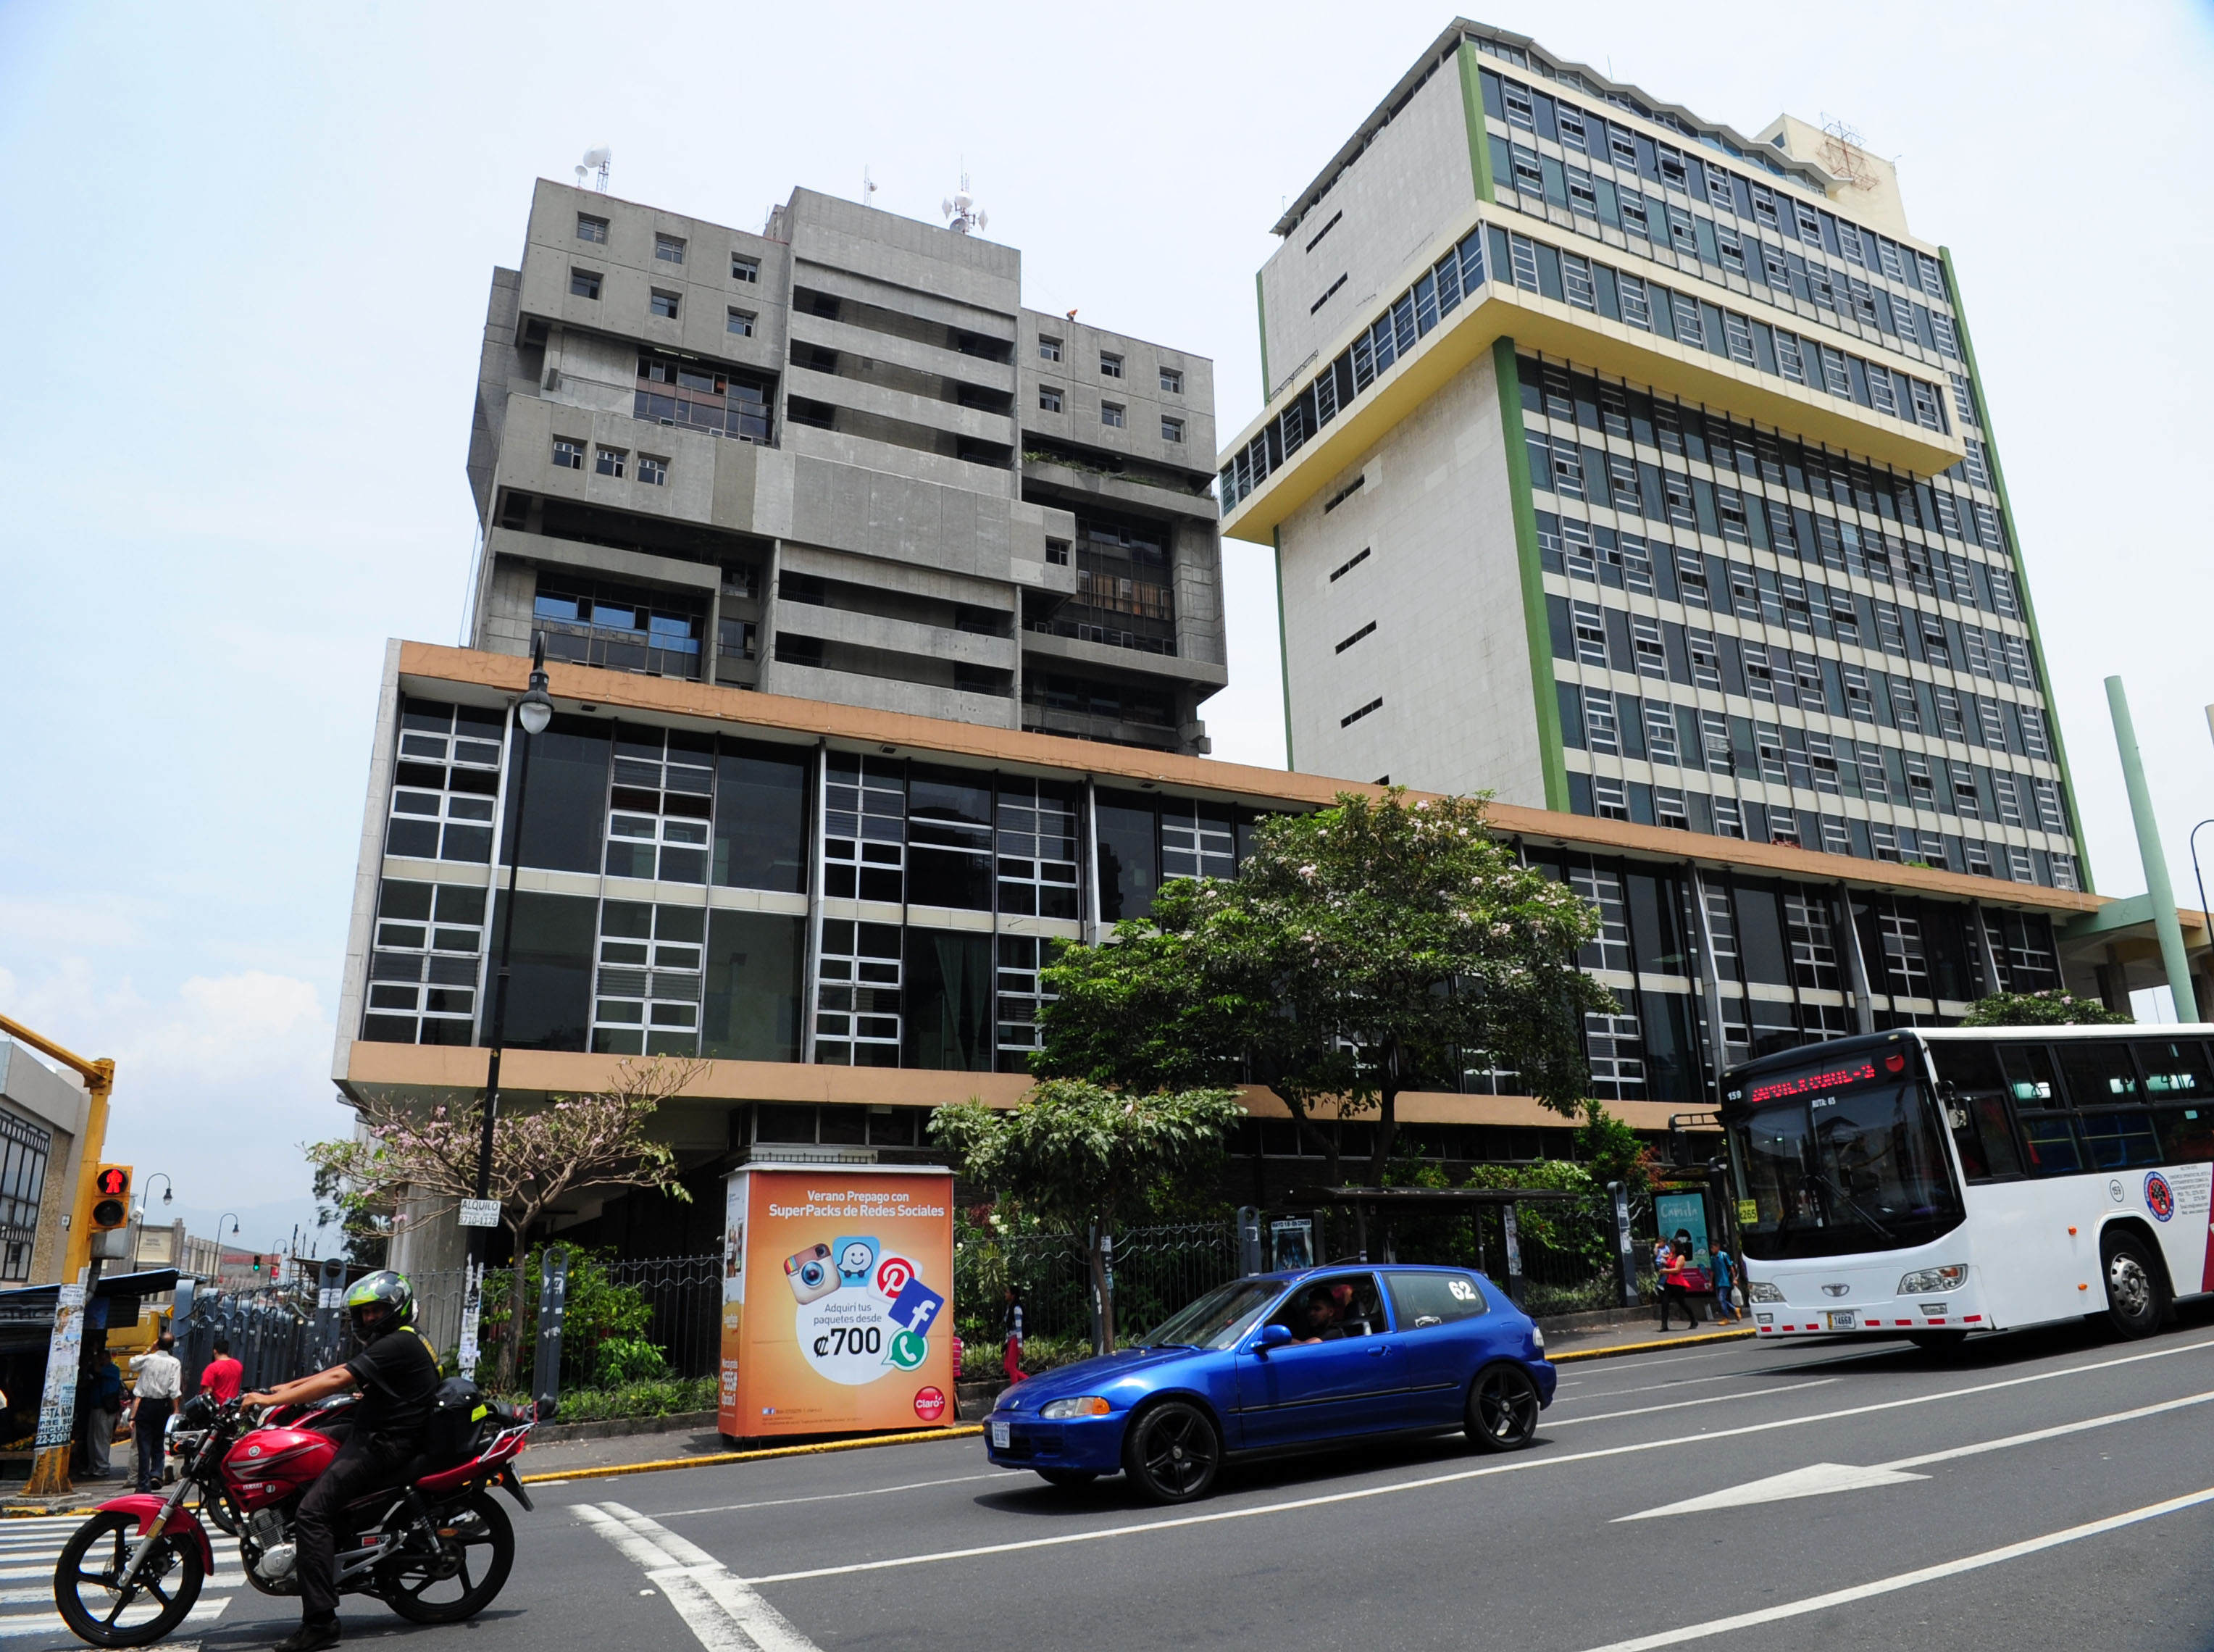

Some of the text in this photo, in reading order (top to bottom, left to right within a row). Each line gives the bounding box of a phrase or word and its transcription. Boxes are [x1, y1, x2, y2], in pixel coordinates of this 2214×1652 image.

[1727, 1090, 1742, 1101] 159
[807, 1190, 909, 1204] Verano Prepago con
[461, 1200, 498, 1211] ALQUILO
[769, 1203, 945, 1219] SuperPacks de Redes Sociales
[1660, 1201, 1699, 1218] Camila
[1448, 1280, 1476, 1301] 62
[814, 1313, 882, 1326] paquetes desde
[916, 1399, 940, 1409] Claro
[38, 1424, 72, 1433] HICULO
